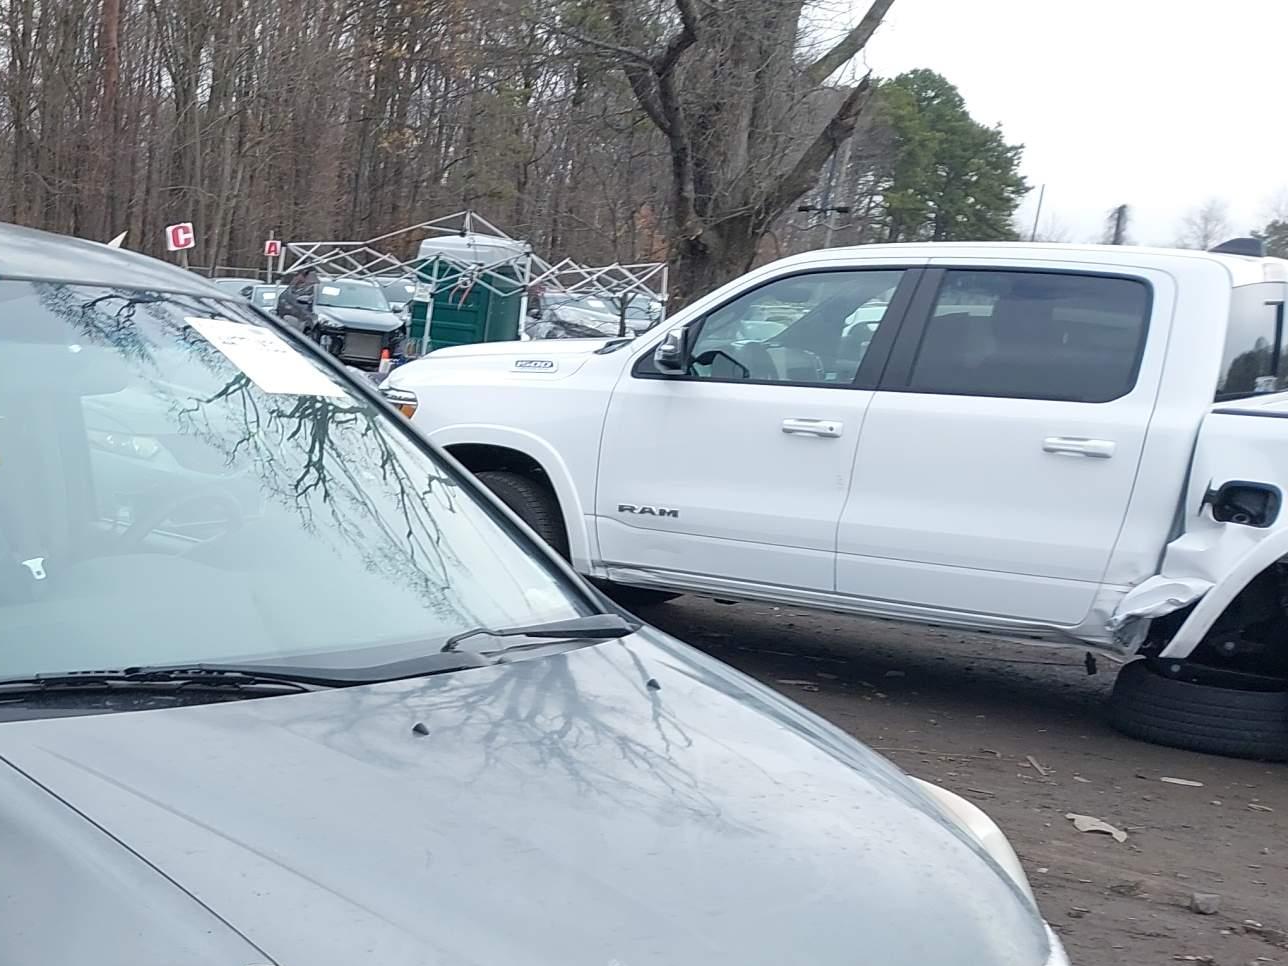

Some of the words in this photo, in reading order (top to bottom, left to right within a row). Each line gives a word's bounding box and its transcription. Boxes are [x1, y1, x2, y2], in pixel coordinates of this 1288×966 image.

[172, 225, 193, 249] C
[267, 241, 278, 255] A
[616, 503, 680, 519] RAM
